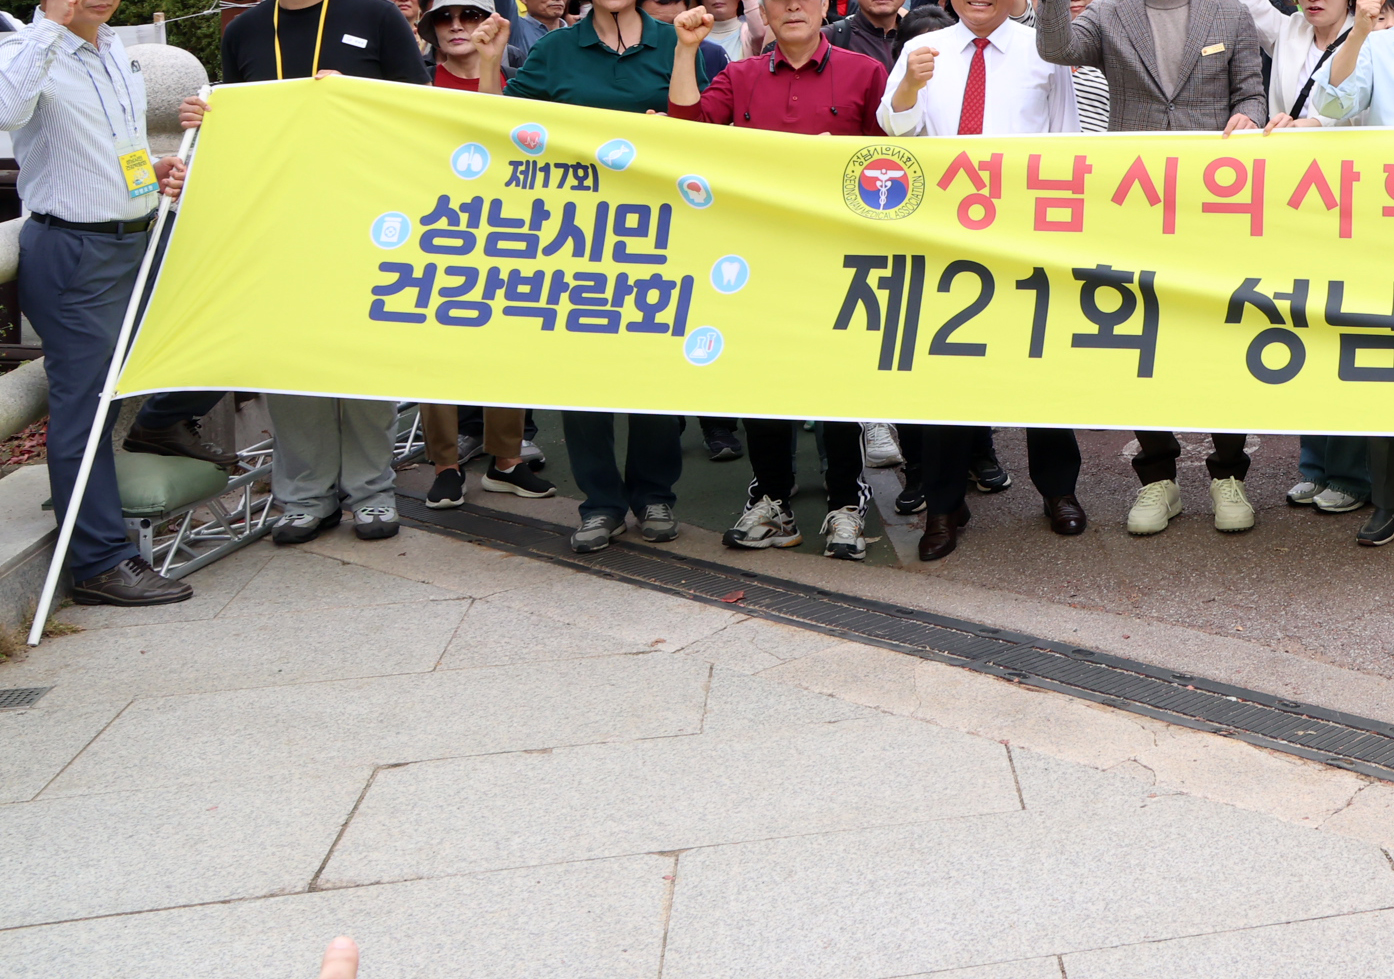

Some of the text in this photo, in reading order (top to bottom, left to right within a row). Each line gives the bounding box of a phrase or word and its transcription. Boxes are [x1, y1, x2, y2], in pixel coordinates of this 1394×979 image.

[504, 159, 600, 193] 제17회
[419, 195, 673, 264] 성남시민
[368, 263, 692, 337] 건강박람회
[832, 254, 1160, 378] 제21회
